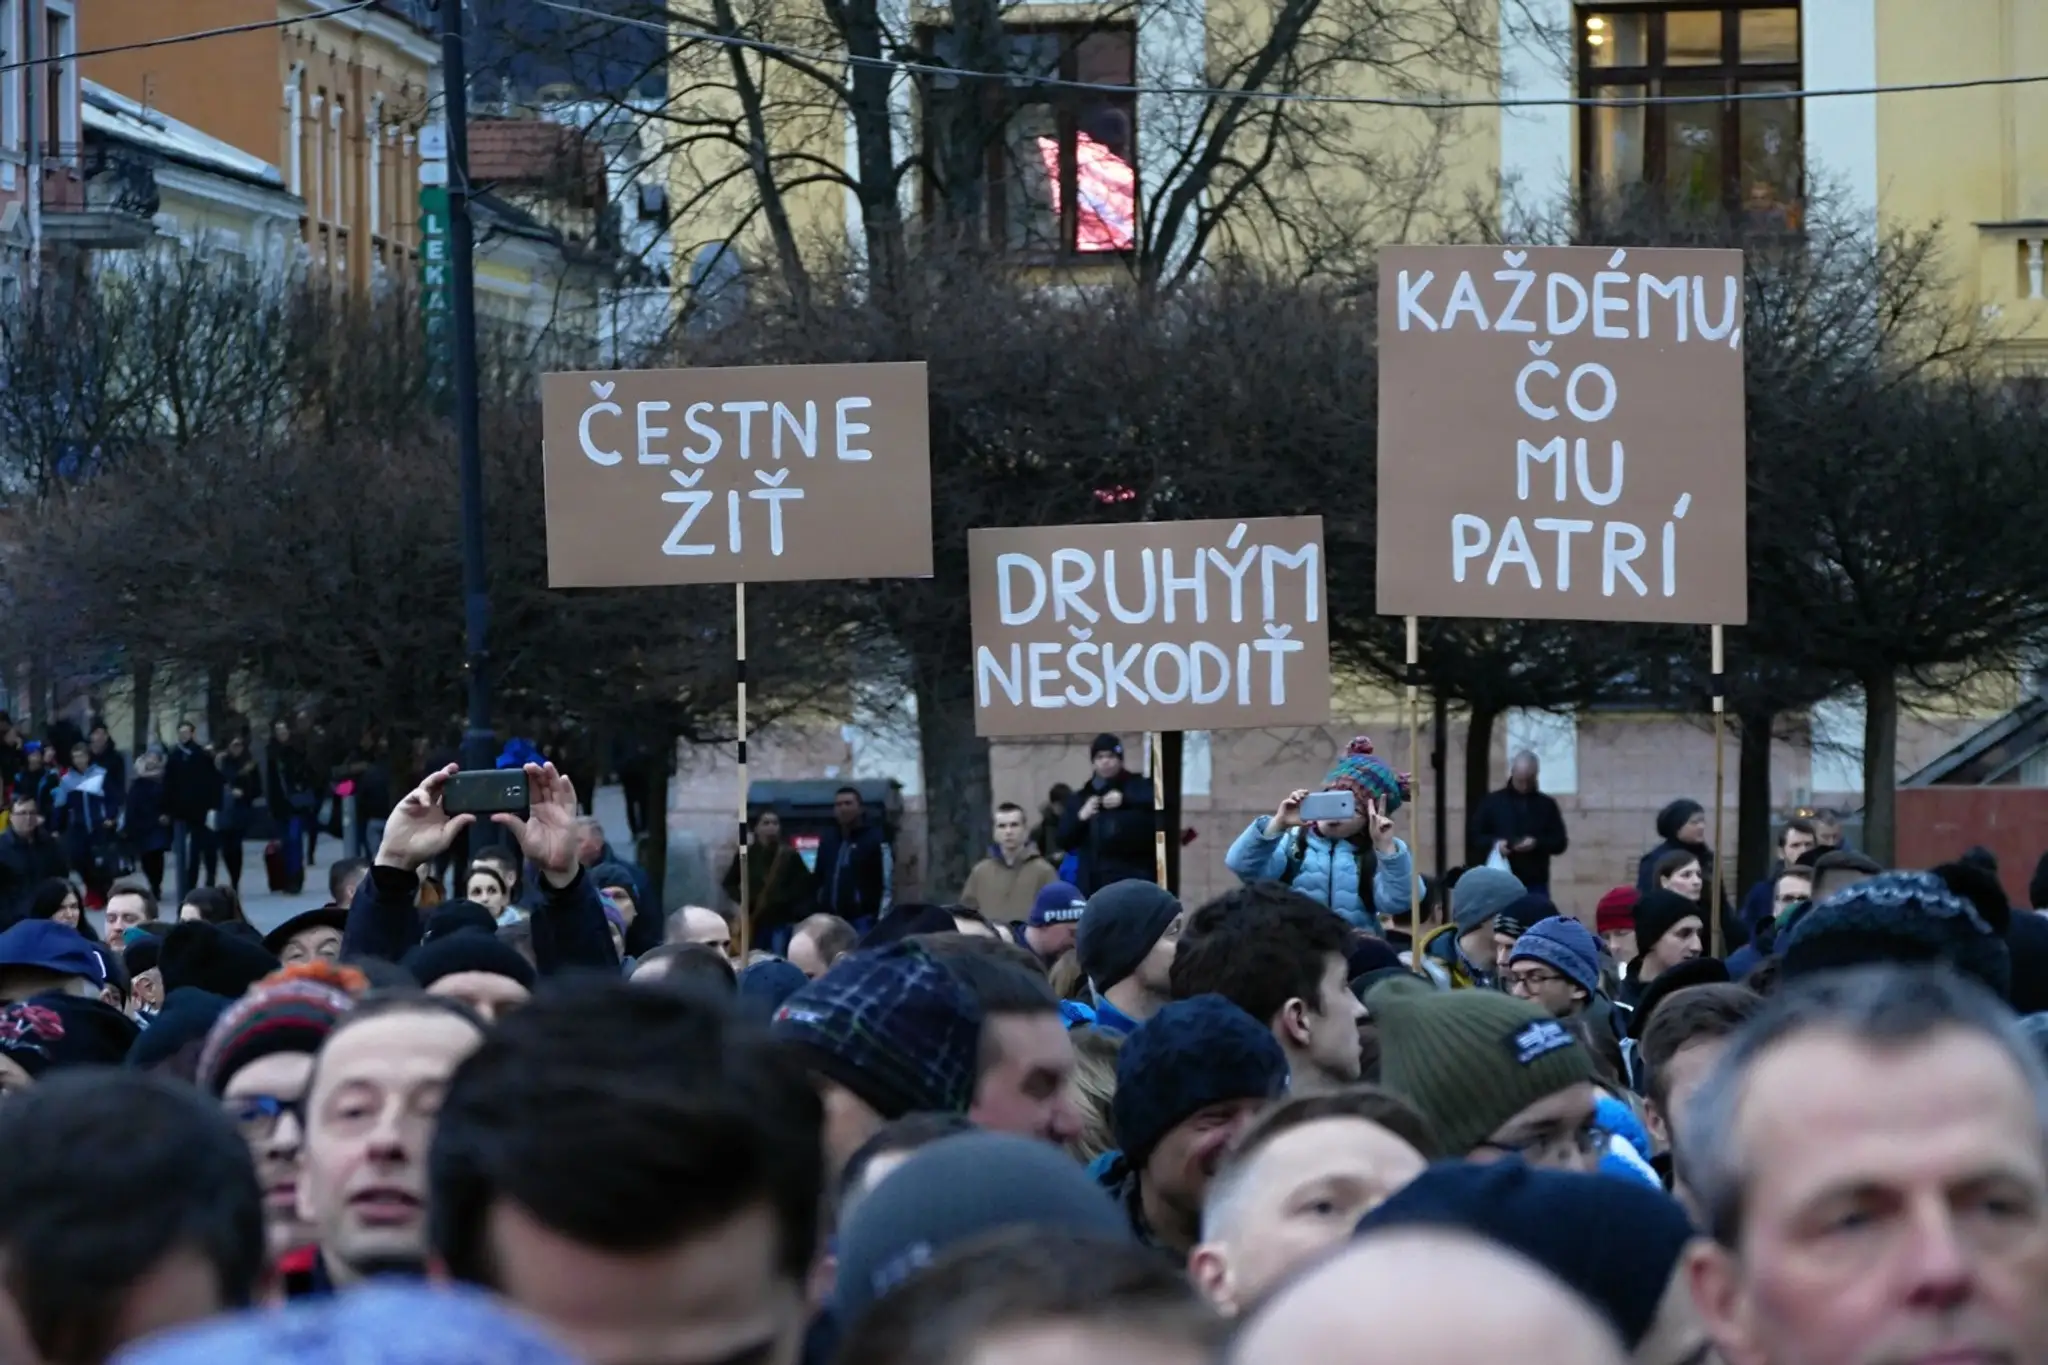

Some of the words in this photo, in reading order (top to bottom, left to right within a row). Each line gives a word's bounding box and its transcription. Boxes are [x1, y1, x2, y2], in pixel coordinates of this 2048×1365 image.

[1397, 248, 1741, 351] KAŽDÉMU,
[578, 379, 873, 466] ČESTNE
[1515, 340, 1618, 422] ČO
[660, 467, 805, 556] ŽIŤ
[1516, 436, 1625, 506] MU
[997, 522, 1320, 626] DRUHÝM
[1451, 492, 1692, 597] PATRÍ
[976, 623, 1305, 709] NEŠKODIŤ
[1043, 908, 1085, 923] PUM
